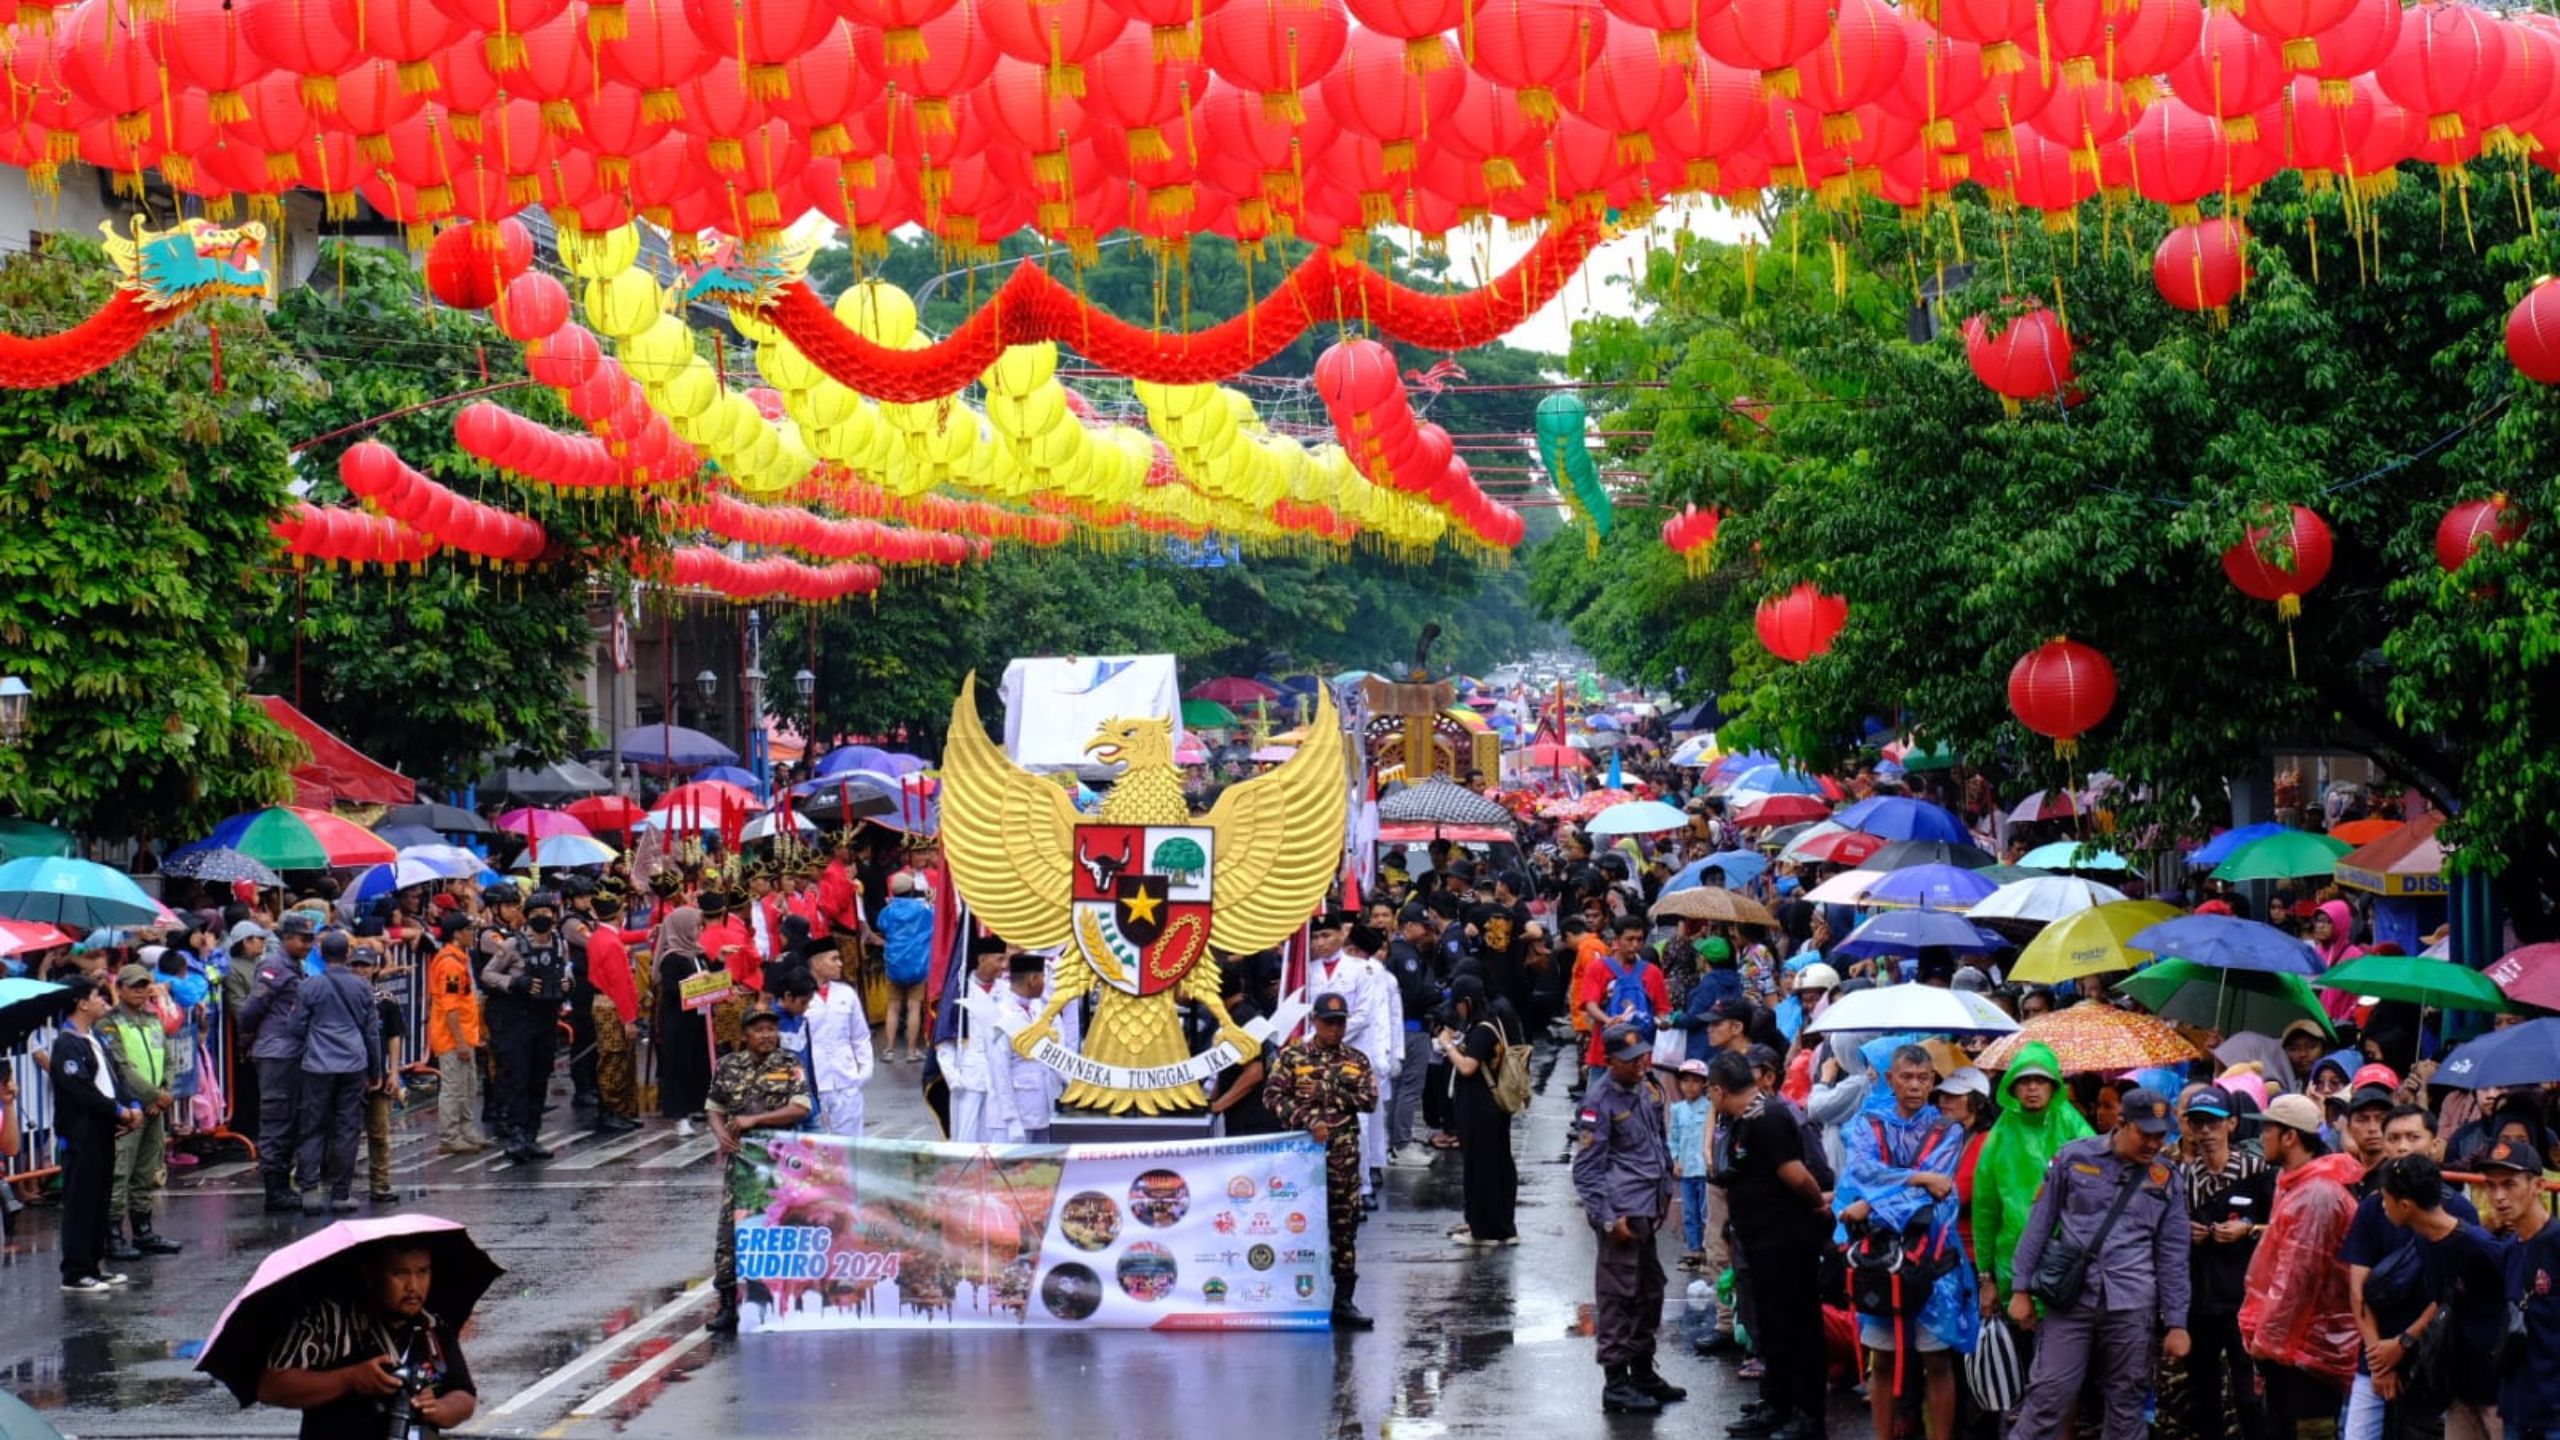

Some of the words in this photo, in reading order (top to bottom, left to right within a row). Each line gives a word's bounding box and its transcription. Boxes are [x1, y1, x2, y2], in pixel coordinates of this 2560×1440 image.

[1039, 1042, 1112, 1086] BHINNEKA
[1128, 1070, 1194, 1088] TUNGGAL
[1204, 1049, 1232, 1073] IKA
[1154, 1145, 1210, 1159] DALAM
[735, 1227, 831, 1252] GREBEG
[735, 1253, 829, 1279] SUDIRO
[832, 1252, 900, 1280] 2024
